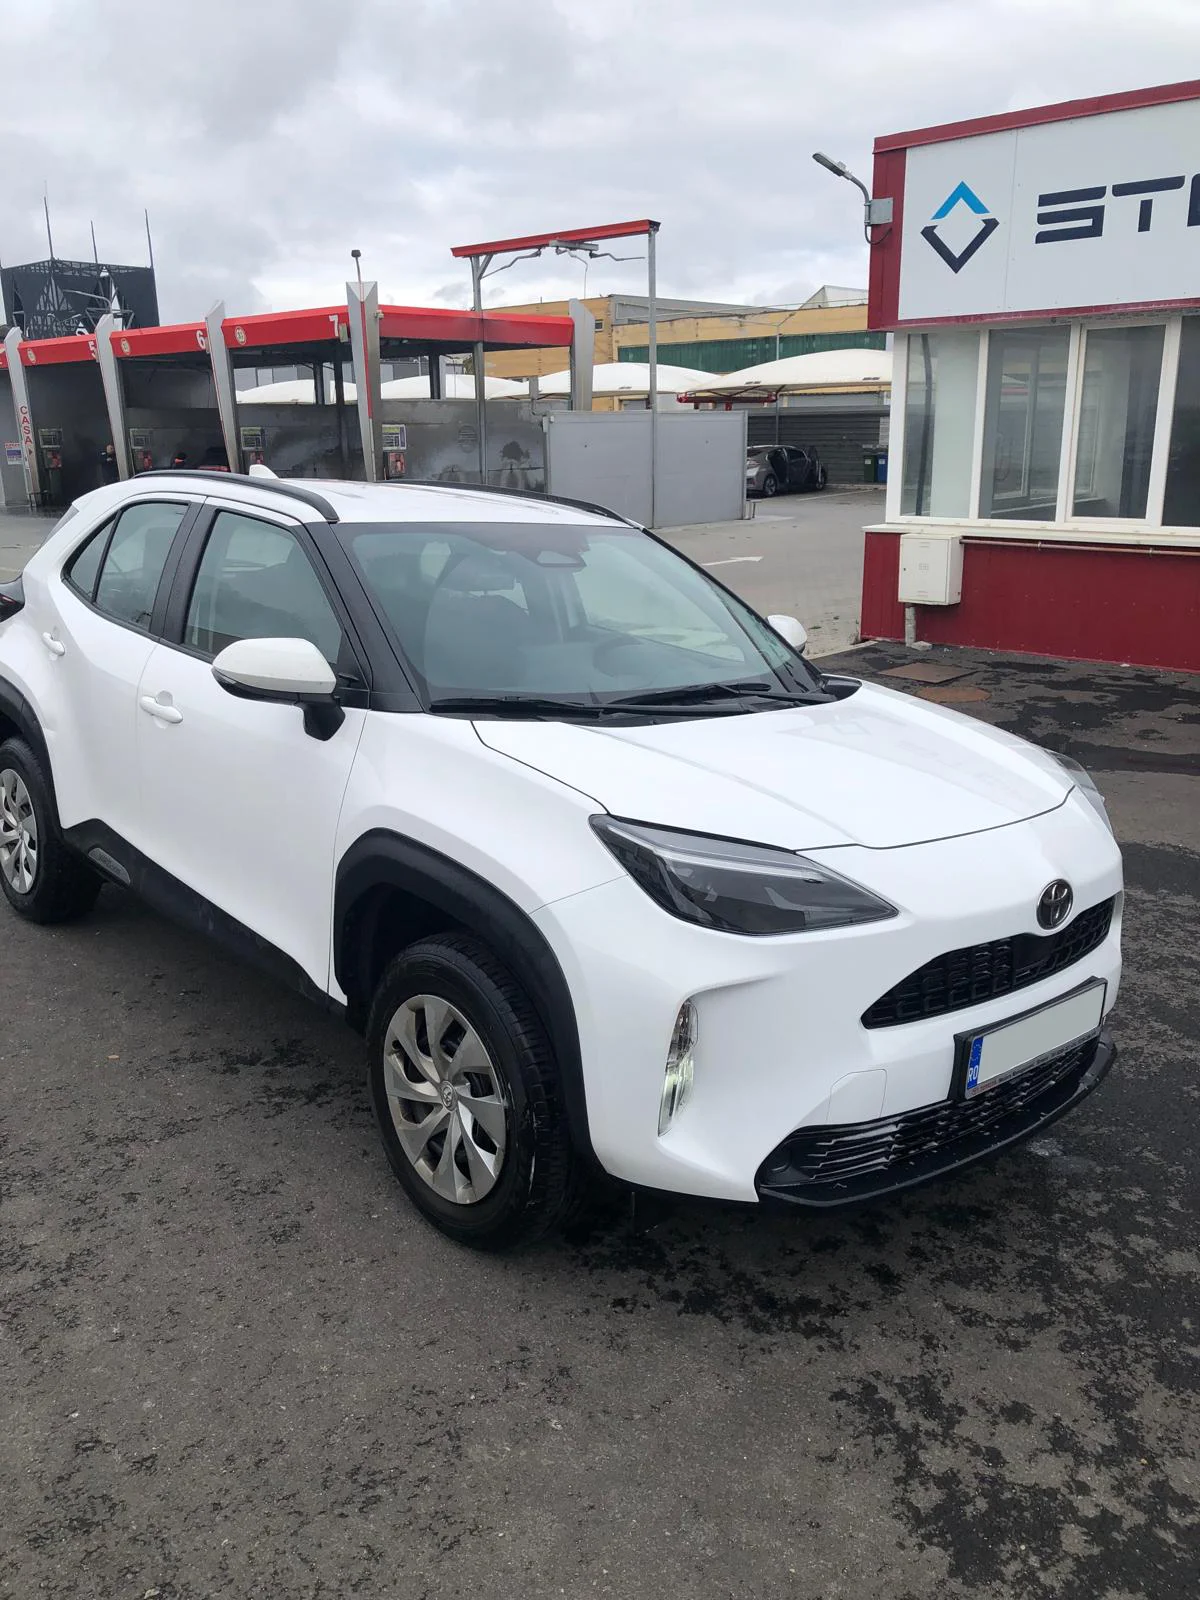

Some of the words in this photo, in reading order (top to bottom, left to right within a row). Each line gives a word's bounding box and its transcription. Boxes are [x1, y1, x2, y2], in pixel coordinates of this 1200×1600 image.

[1035, 173, 1200, 244] ST
[328, 314, 339, 337] 7
[88, 340, 97, 359] 5
[196, 329, 206, 349] 6
[20, 405, 33, 445] CASA
[968, 1065, 979, 1082] RO
